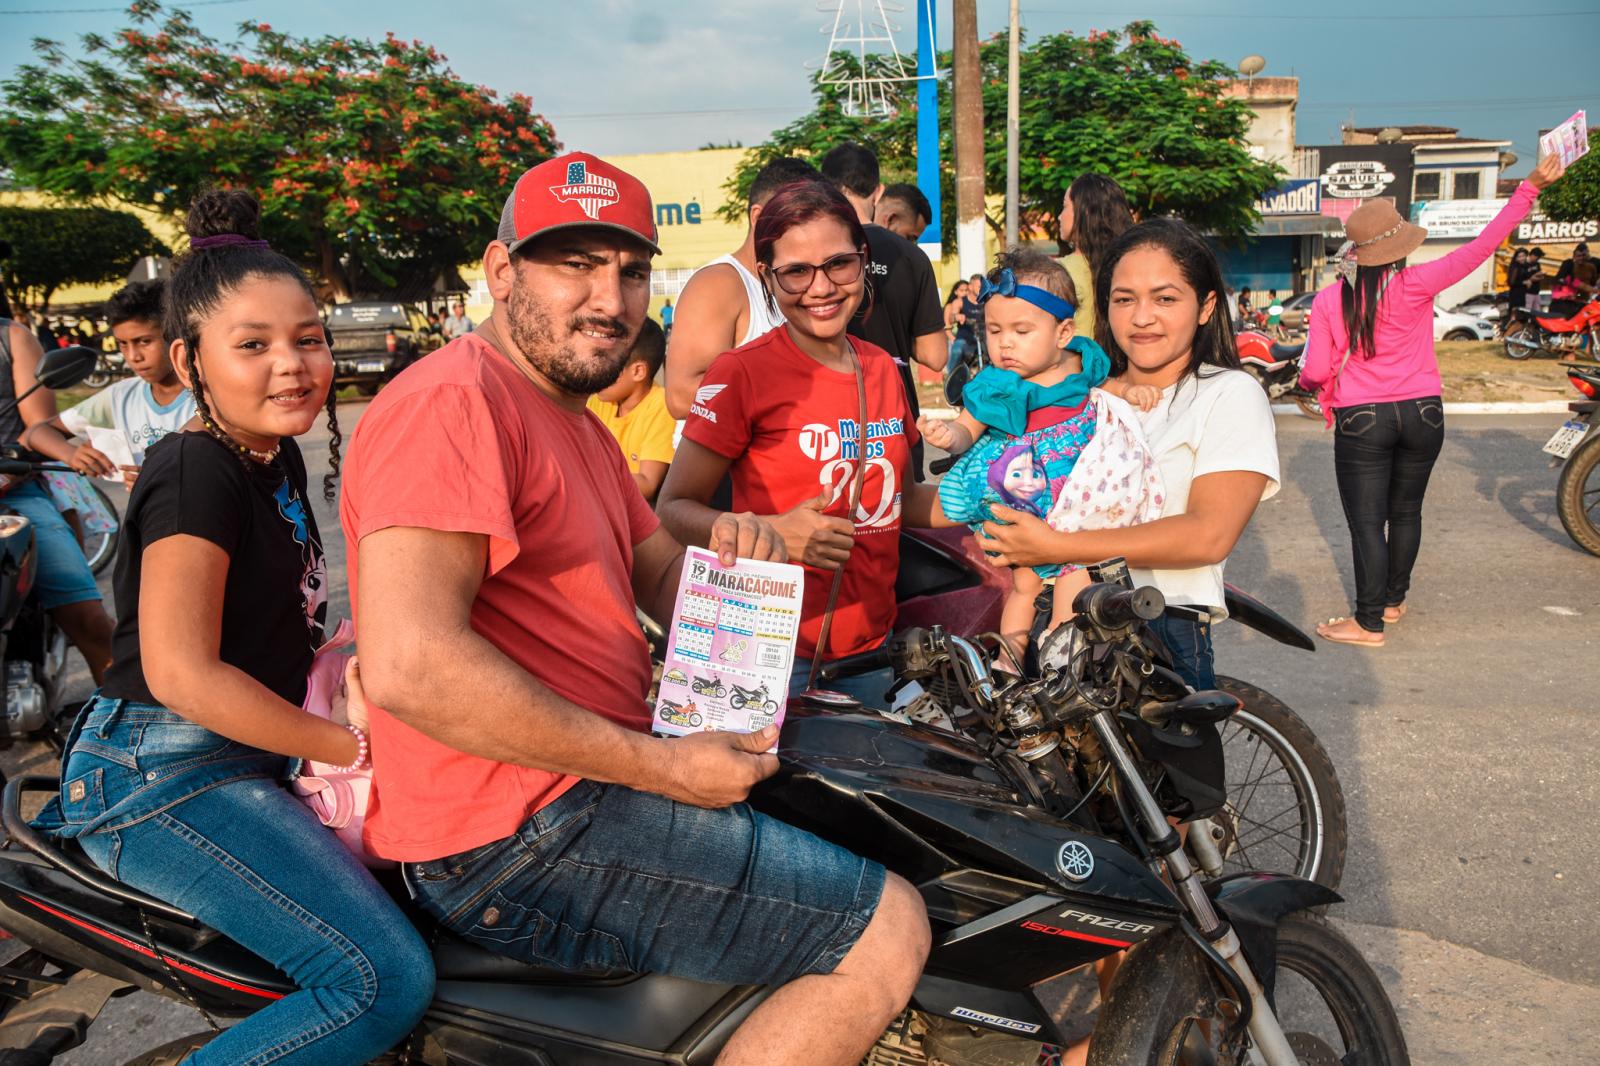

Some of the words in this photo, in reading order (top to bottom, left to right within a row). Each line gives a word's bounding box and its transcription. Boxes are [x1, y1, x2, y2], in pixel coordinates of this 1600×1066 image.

[1328, 174, 1384, 182] SAMUEL
[562, 185, 615, 197] MARRUCO
[1253, 181, 1317, 214] ALVADOR
[656, 197, 701, 226] mé
[1518, 220, 1598, 239] BARROS
[690, 403, 717, 424] ONDA
[840, 439, 884, 460] Mos
[692, 564, 706, 576] 19
[708, 569, 798, 599] MARACAÇUMÉ
[1020, 919, 1063, 935] 150
[1059, 909, 1155, 934] FAZER
